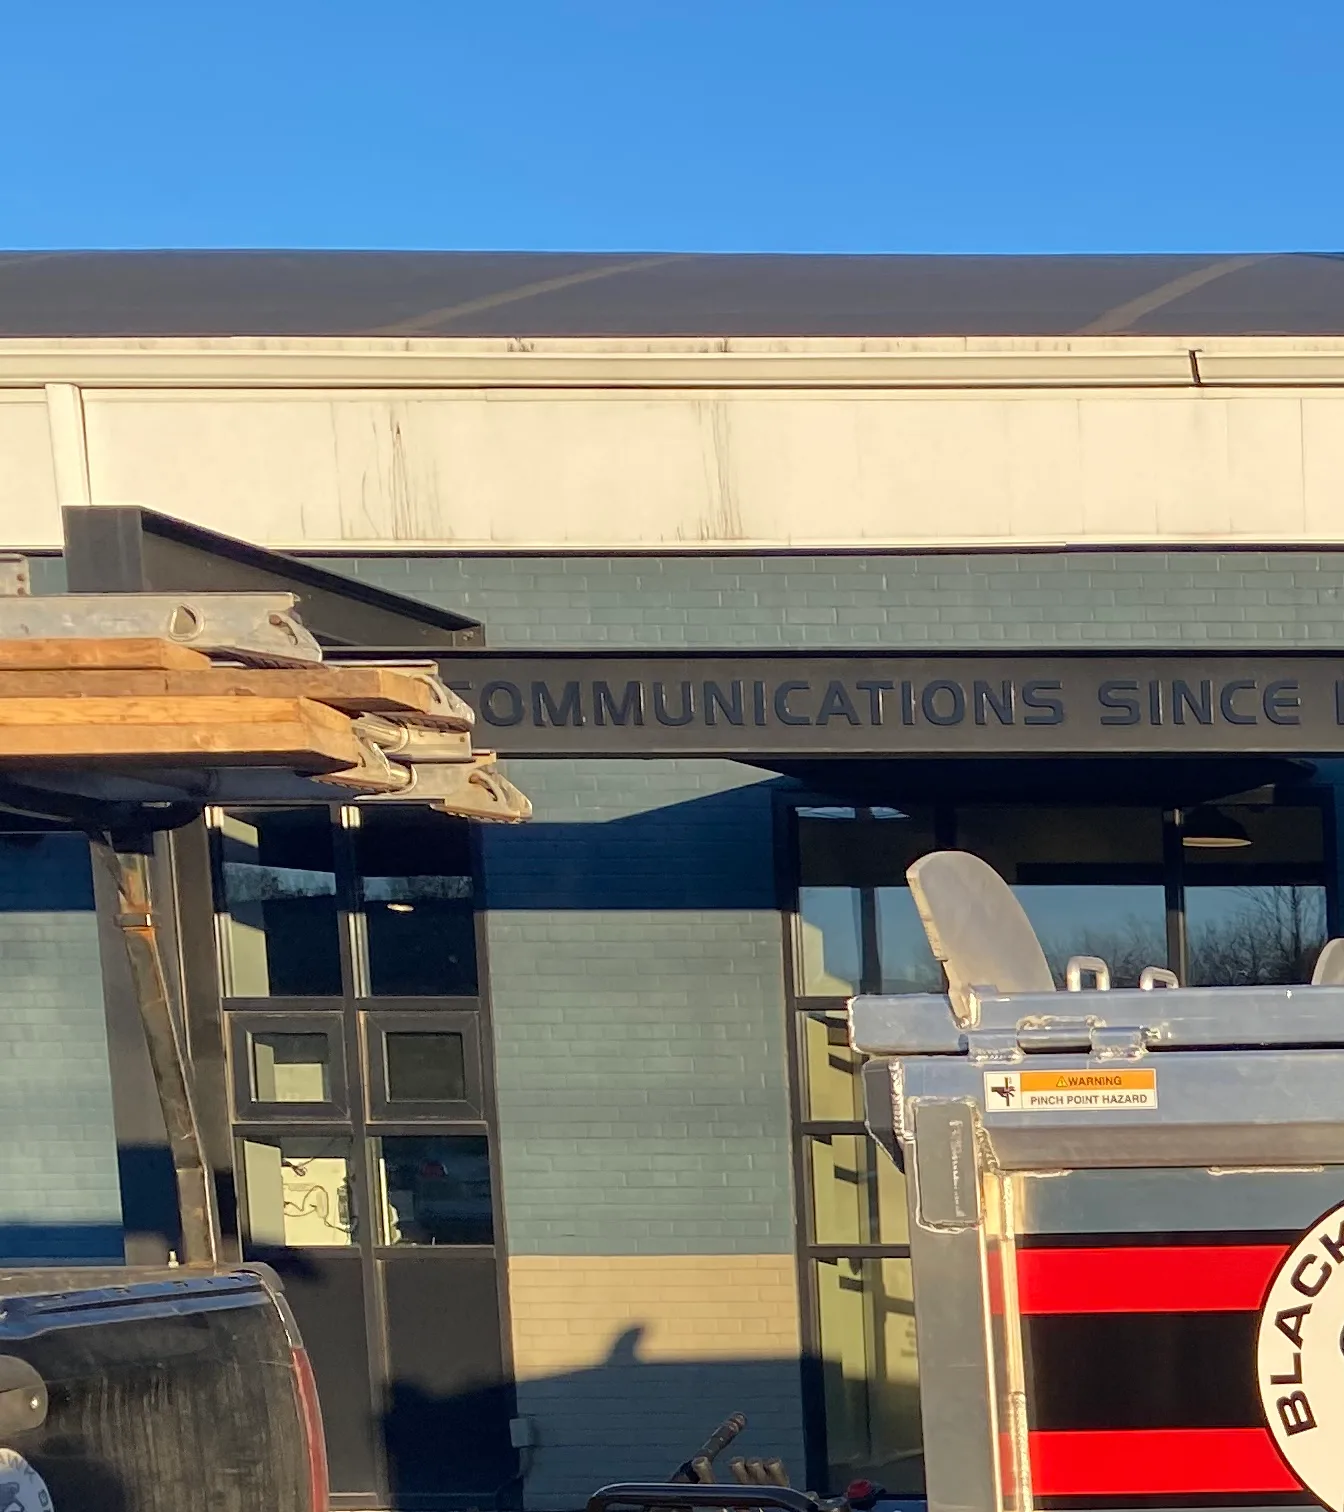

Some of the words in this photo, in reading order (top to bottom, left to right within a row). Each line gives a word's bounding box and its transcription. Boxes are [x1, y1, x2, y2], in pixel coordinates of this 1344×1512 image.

[443, 679, 1065, 728] OMMUNICATIONS
[1098, 679, 1300, 726] SINCE
[1067, 1076, 1122, 1086] WARNING
[1030, 1095, 1064, 1105] PINCH
[1067, 1095, 1099, 1105] POINT
[1102, 1094, 1147, 1104] HAZARD
